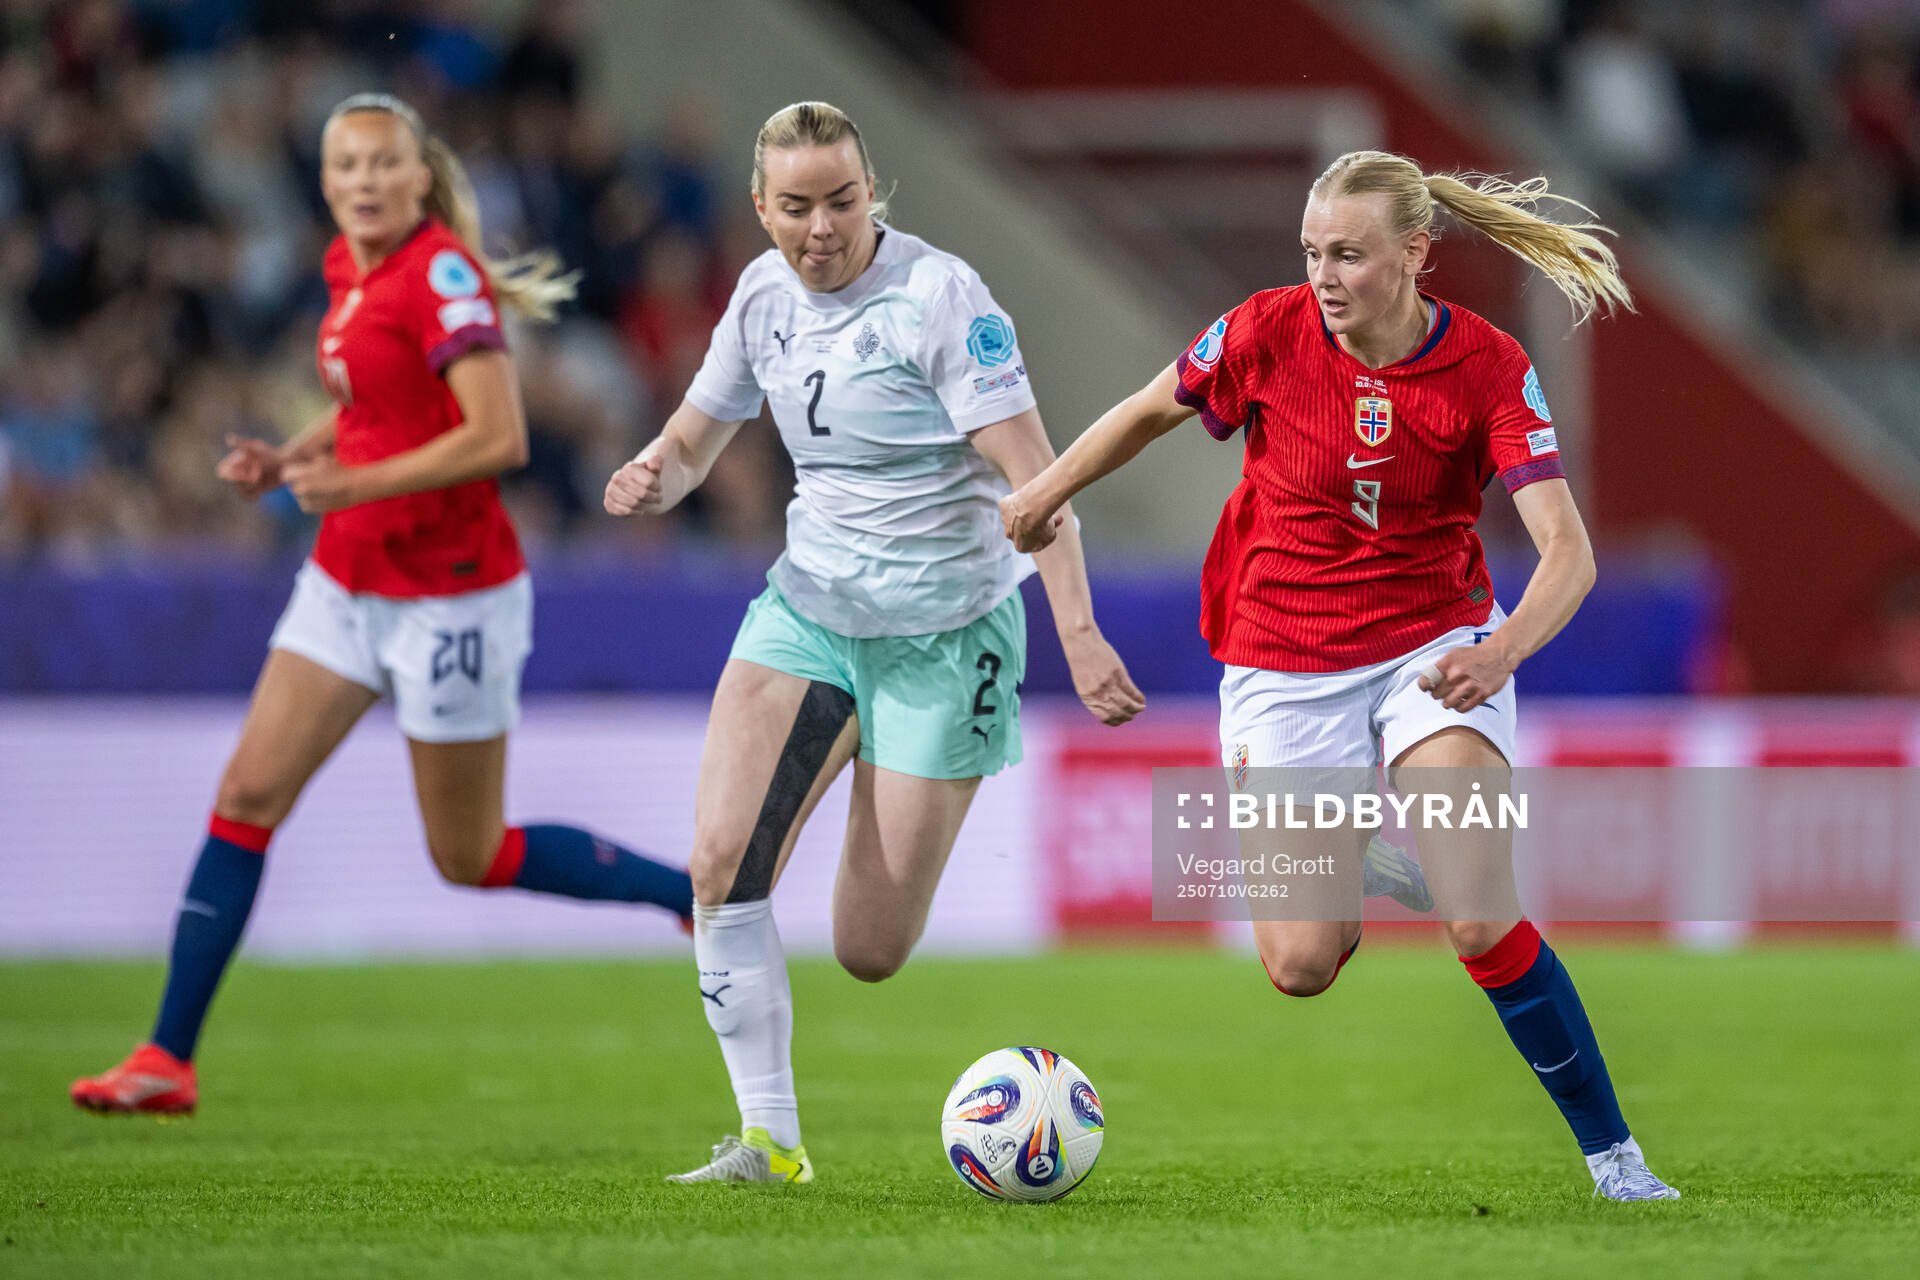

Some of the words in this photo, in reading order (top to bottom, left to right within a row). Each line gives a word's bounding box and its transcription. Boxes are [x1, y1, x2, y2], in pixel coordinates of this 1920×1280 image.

[803, 370, 831, 436] 2
[1351, 480, 1381, 530] 9
[432, 629, 482, 684] 20
[973, 653, 1002, 716] 2
